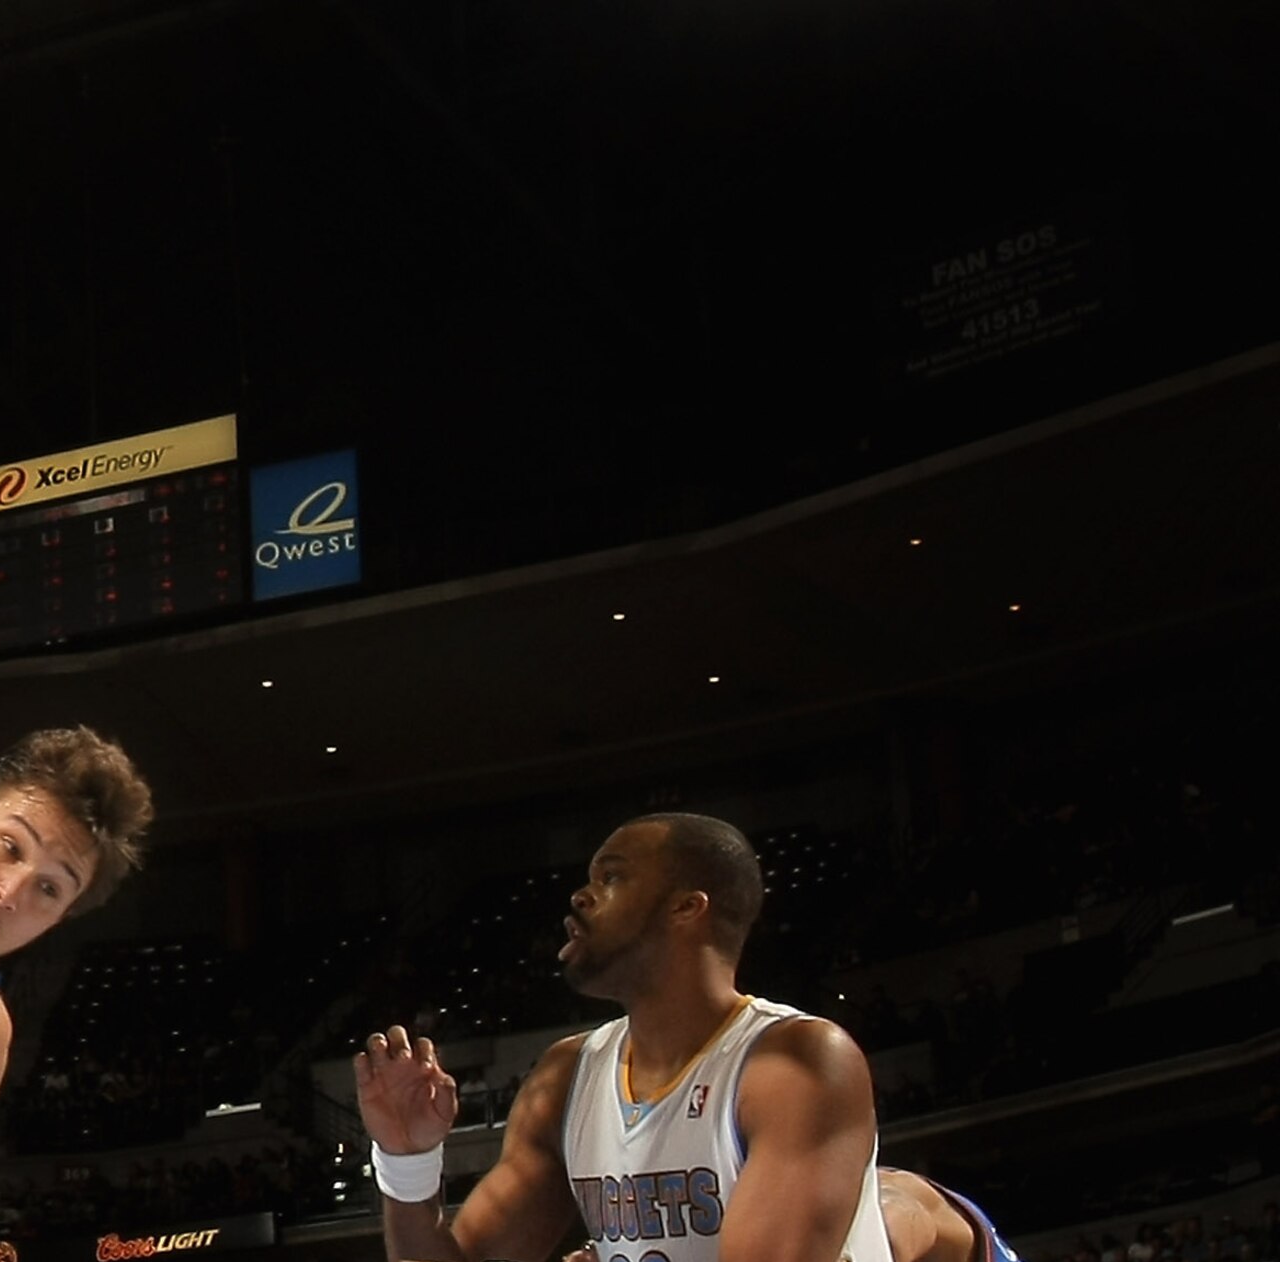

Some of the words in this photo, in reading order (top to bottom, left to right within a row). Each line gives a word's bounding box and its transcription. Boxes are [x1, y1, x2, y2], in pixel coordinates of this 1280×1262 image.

[932, 247, 988, 286] FAN
[995, 225, 1057, 262] SOS
[961, 298, 1039, 340] 41513
[255, 531, 357, 569] Qwest
[156, 1227, 222, 1253] LIGHT
